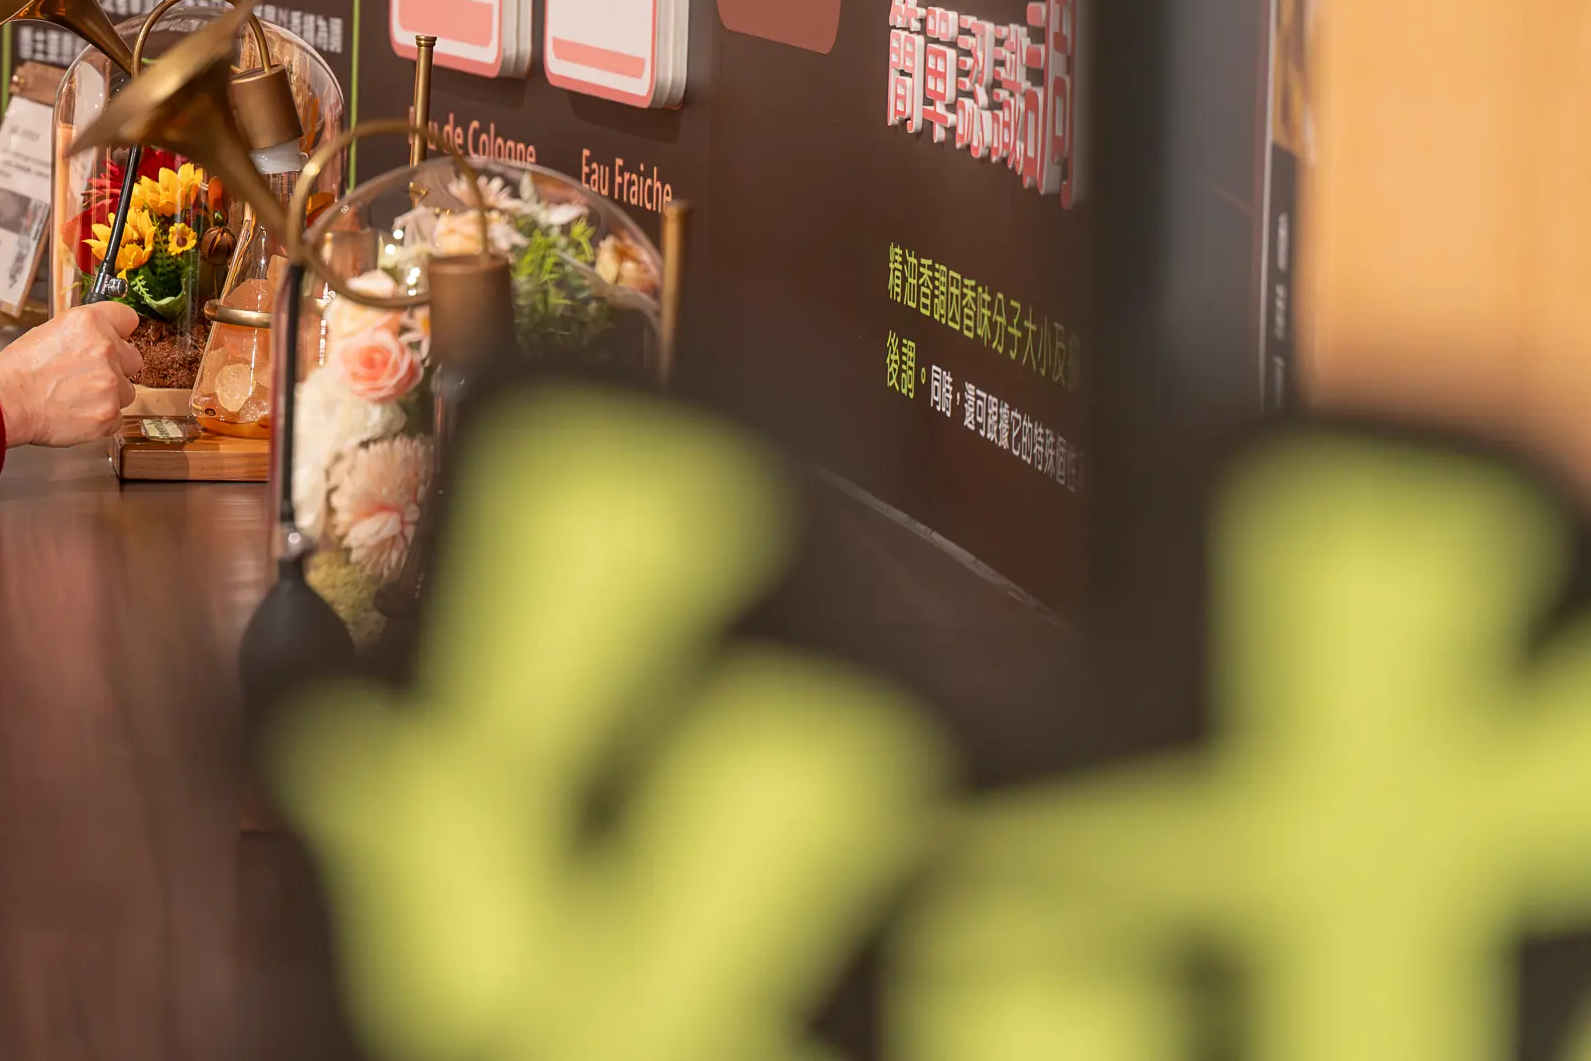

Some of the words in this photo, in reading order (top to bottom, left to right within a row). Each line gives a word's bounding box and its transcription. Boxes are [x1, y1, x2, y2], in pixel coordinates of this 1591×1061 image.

[443, 111, 464, 155] de
[581, 149, 609, 197] Eau
[614, 157, 673, 213] Fraiche
[888, 242, 1081, 393] 精油香調因香味分子大小及
